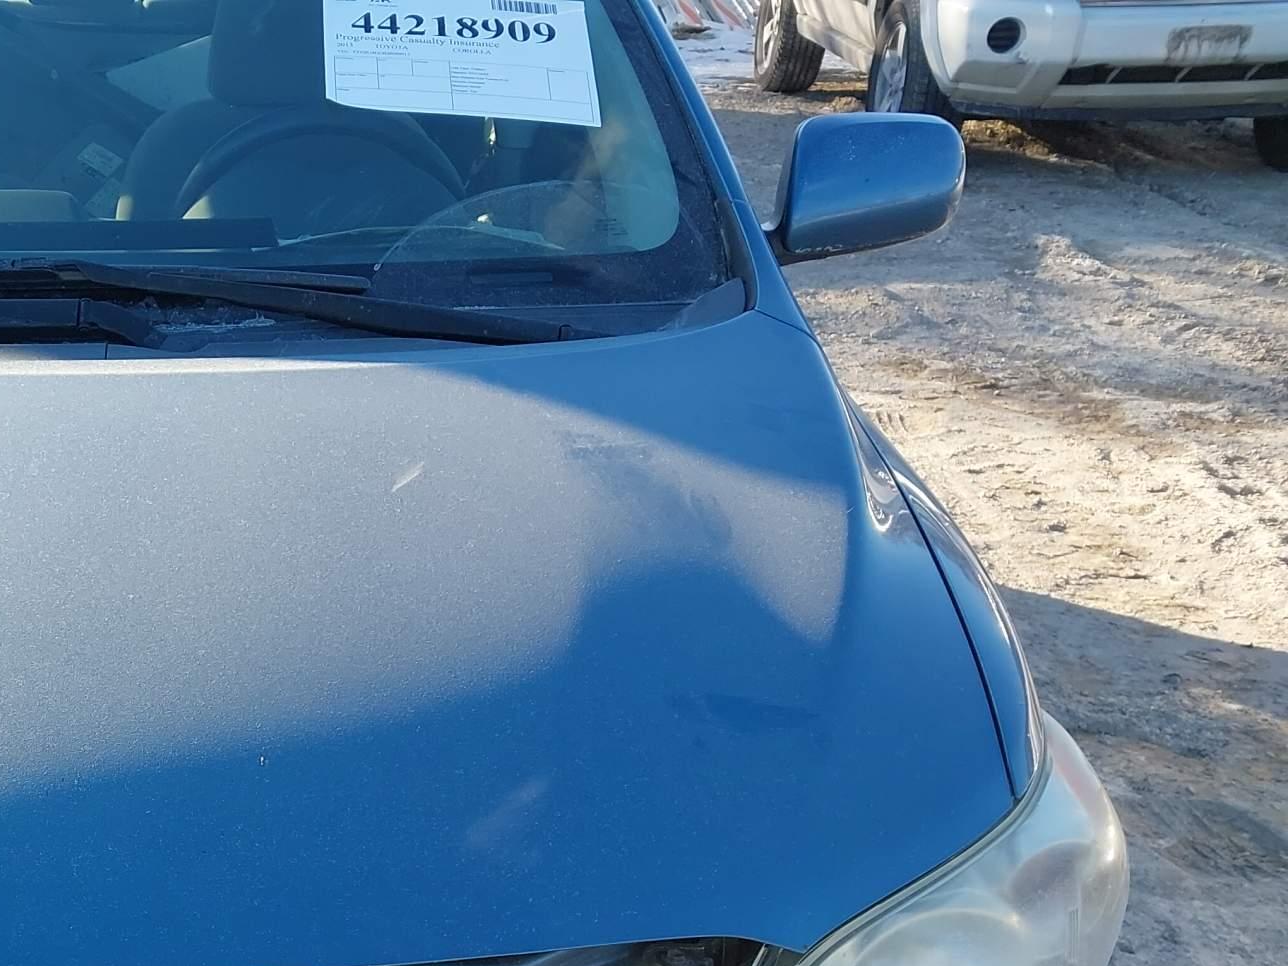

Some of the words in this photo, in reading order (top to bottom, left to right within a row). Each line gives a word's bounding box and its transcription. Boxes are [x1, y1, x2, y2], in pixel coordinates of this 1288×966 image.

[351, 11, 557, 45] 44218909
[335, 33, 397, 43] Progressive
[399, 35, 445, 46] Casualty
[449, 38, 500, 48] Insurance
